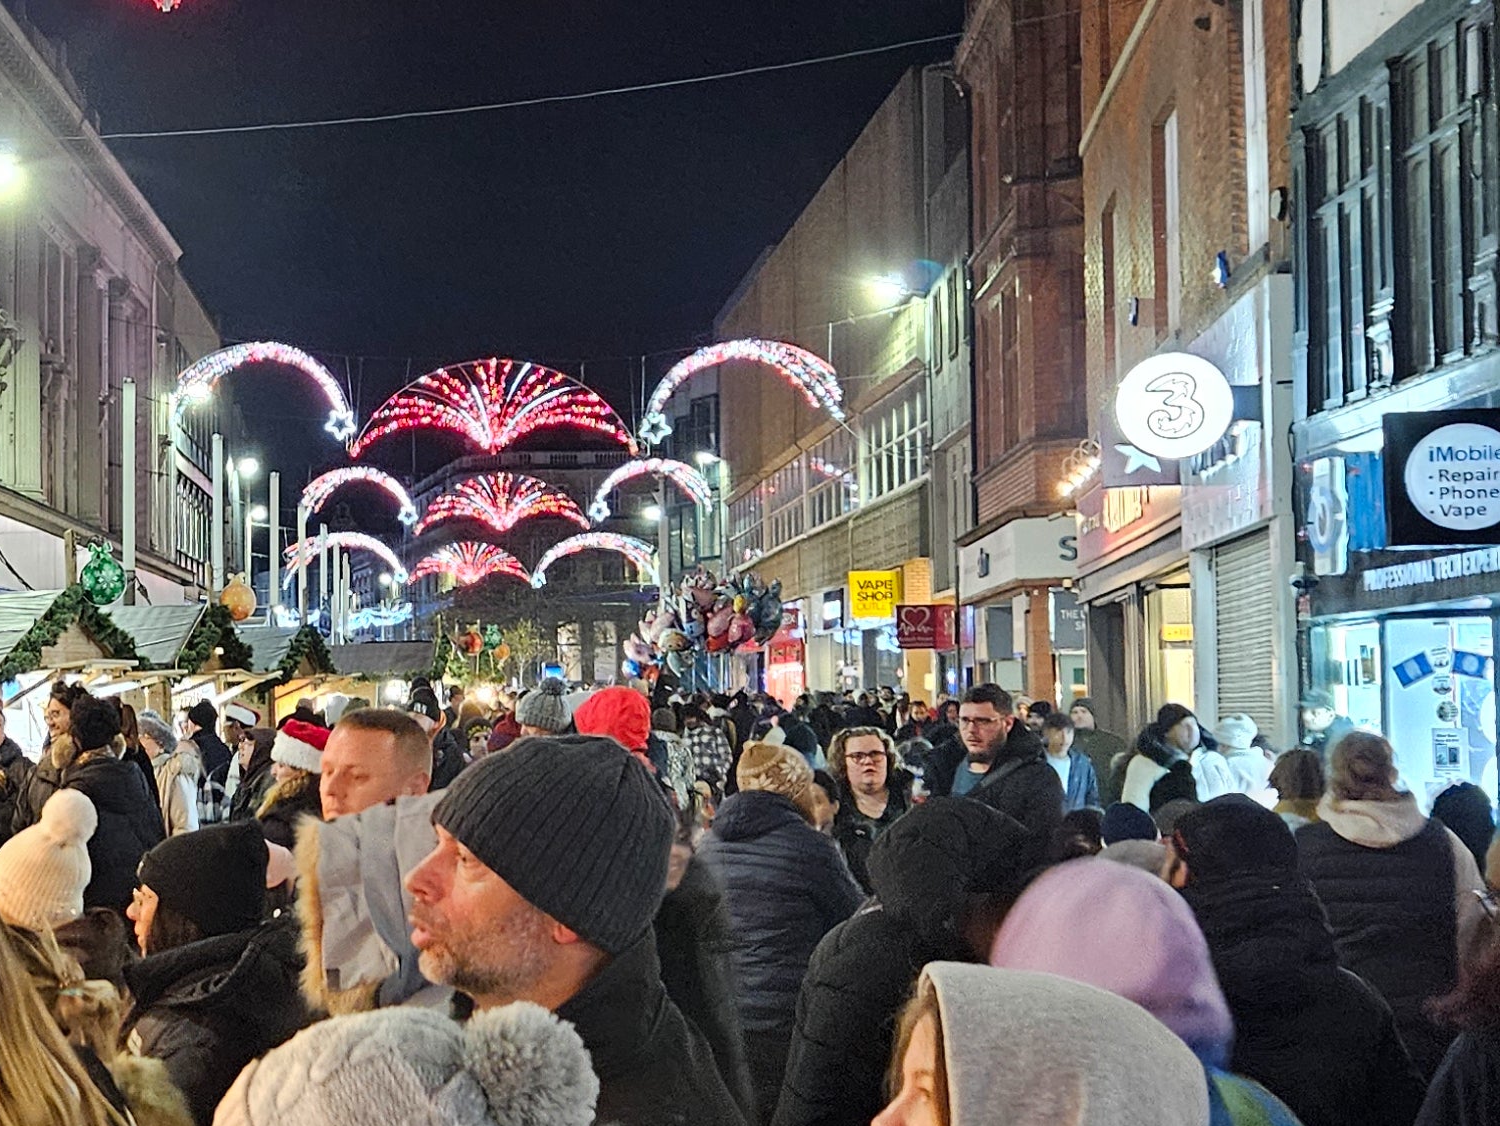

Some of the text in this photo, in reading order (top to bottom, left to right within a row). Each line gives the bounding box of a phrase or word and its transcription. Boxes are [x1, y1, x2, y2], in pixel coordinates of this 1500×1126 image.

[1145, 371, 1205, 439] 3
[1440, 485, 1500, 500] Phone
[1440, 504, 1488, 520] Vape
[1363, 559, 1435, 591] PROFESSIONAL
[1432, 553, 1462, 580] TECH
[857, 580, 893, 590] VAPE
[857, 591, 893, 601] SHOP
[1060, 609, 1079, 620] THE
